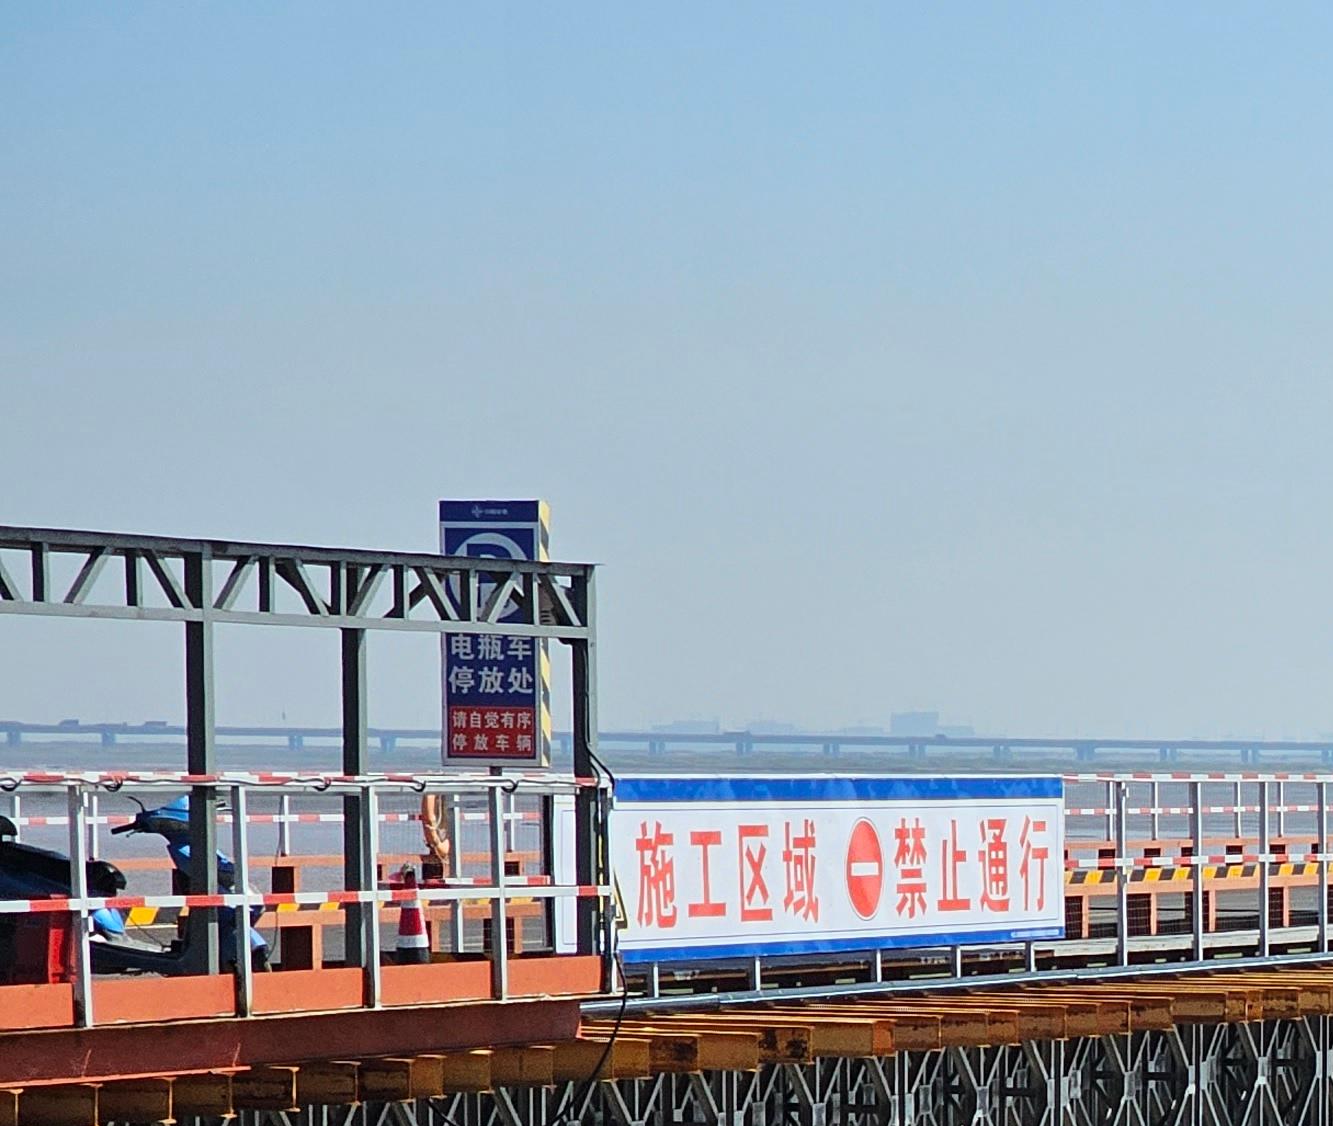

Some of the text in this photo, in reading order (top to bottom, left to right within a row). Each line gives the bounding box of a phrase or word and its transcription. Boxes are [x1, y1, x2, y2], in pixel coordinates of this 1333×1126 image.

[451, 633, 532, 660] 电瓶车
[448, 665, 533, 694] 停放处
[452, 710, 532, 729] 请自觉有序
[452, 733, 532, 751] 停放车辆
[635, 816, 1049, 928] 施工区域 禁止通行
